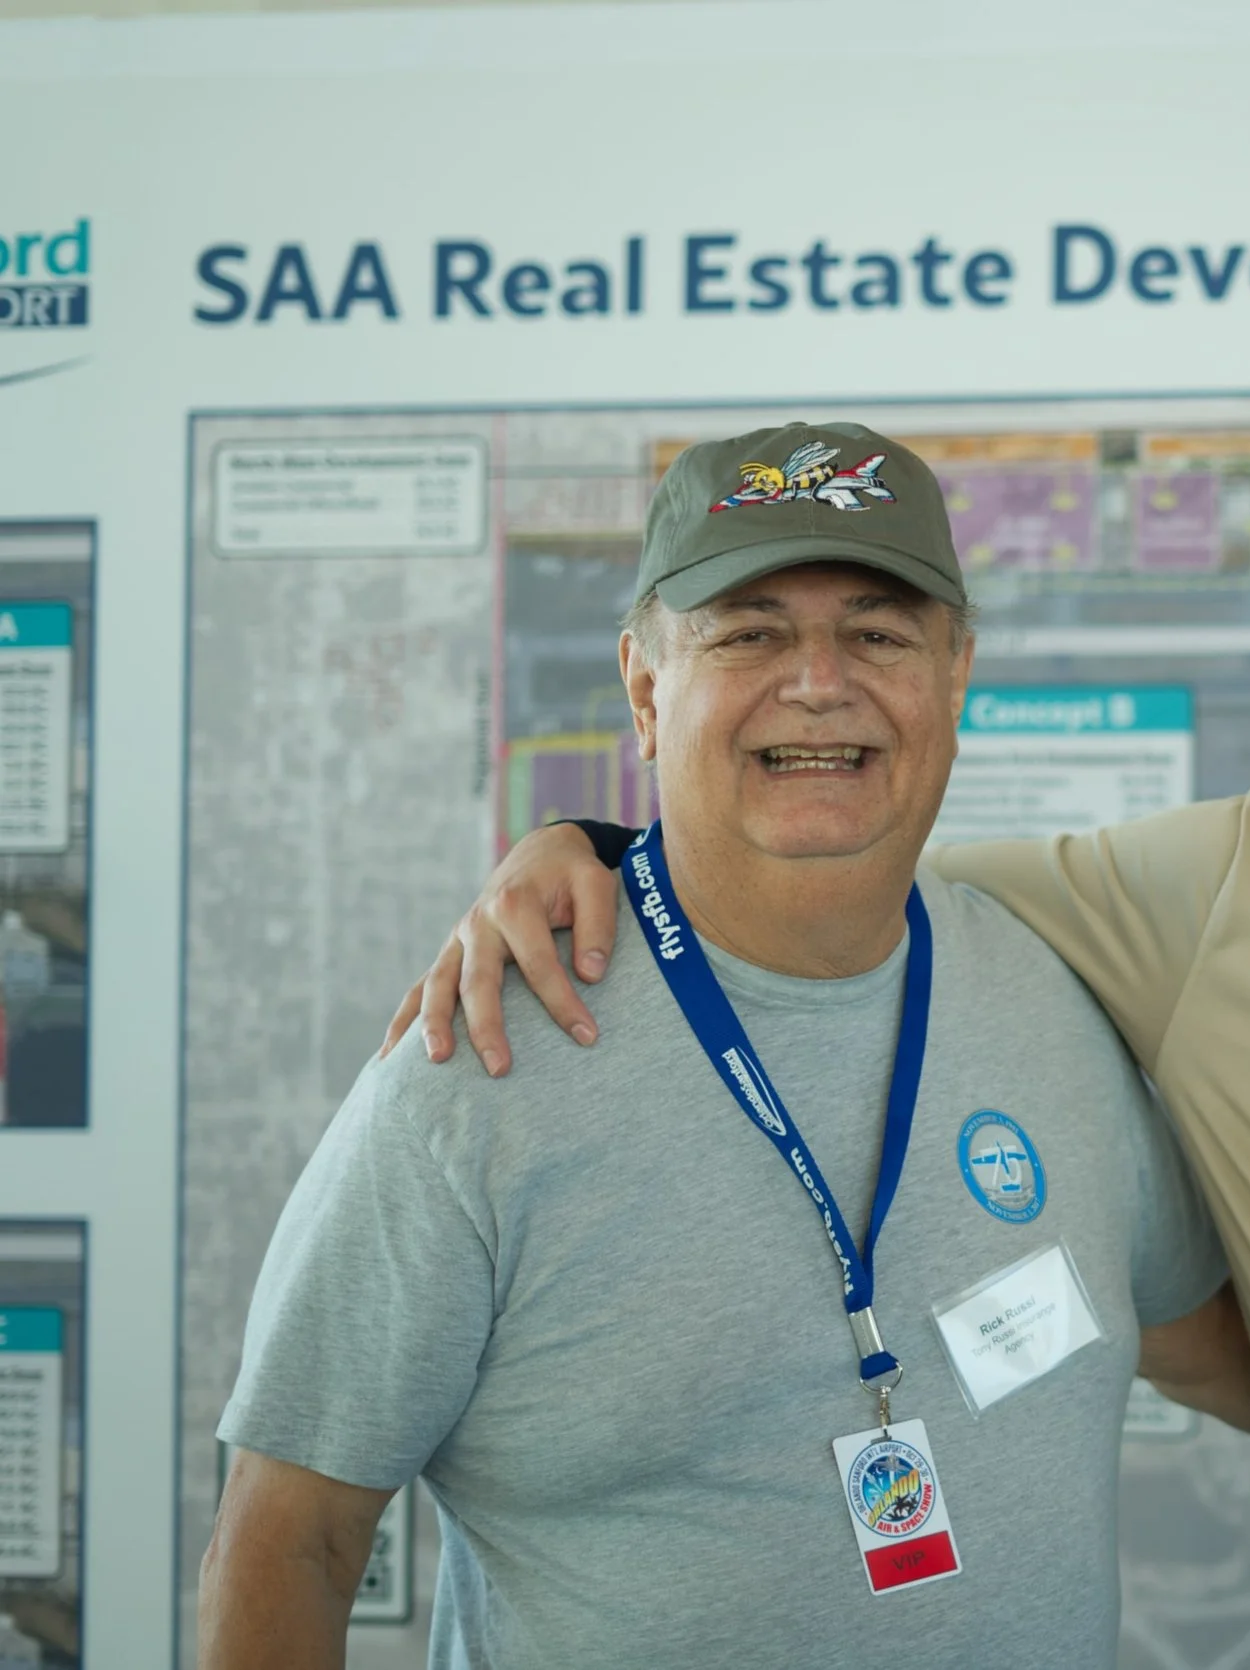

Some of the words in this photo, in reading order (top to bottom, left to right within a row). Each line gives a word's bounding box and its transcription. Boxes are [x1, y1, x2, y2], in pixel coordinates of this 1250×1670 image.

[0, 216, 90, 277] rd
[193, 242, 398, 324] SAA
[434, 236, 643, 318] Real
[684, 234, 1013, 312] Estate
[968, 693, 1105, 734] Concept
[631, 852, 684, 960] flysfb.com
[979, 1315, 1005, 1337] Rick
[1004, 1295, 1036, 1322] Russi
[970, 1342, 993, 1360] Tony
[991, 1326, 1017, 1346] Russi
[1004, 1332, 1036, 1356] Agency
[879, 1443, 903, 1454] AIRPORT
[852, 1456, 869, 1484] SANFORD
[852, 1486, 867, 1514] ORLANDO
[868, 1468, 920, 1528] ORLANDO
[877, 1520, 893, 1534] AIR
[894, 1525, 901, 1535] &
[901, 1511, 925, 1532] SPACE
[921, 1483, 933, 1513] SHOW
[891, 1550, 926, 1571] VIP
